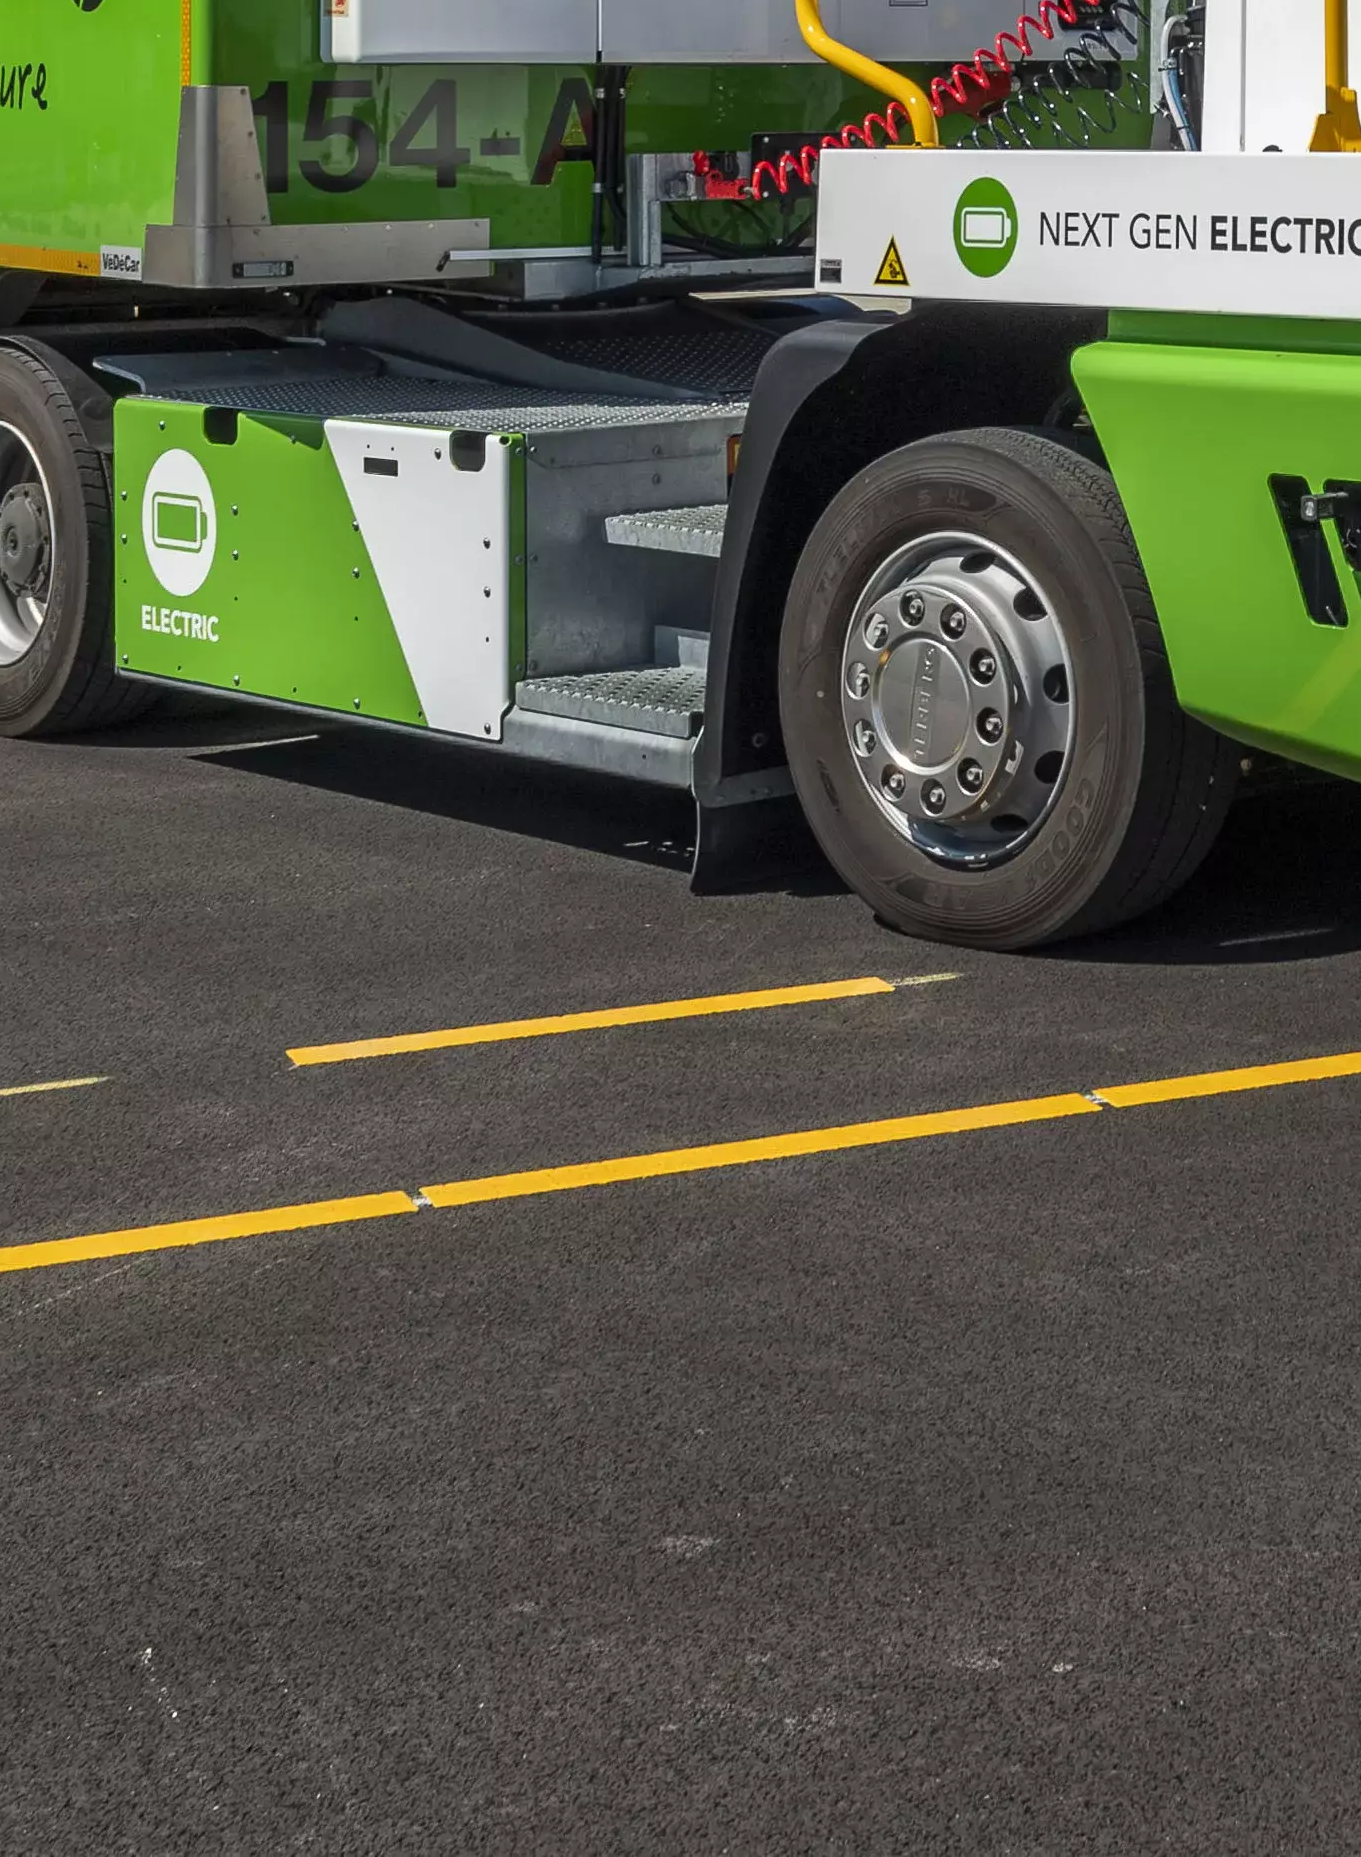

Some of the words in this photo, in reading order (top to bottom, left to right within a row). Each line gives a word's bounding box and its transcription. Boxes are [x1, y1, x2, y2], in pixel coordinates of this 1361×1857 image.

[252, 77, 598, 195] 154-A
[1039, 211, 1120, 248] NEXT
[1129, 214, 1197, 251] GEN
[141, 604, 219, 642] ELECTRIC
